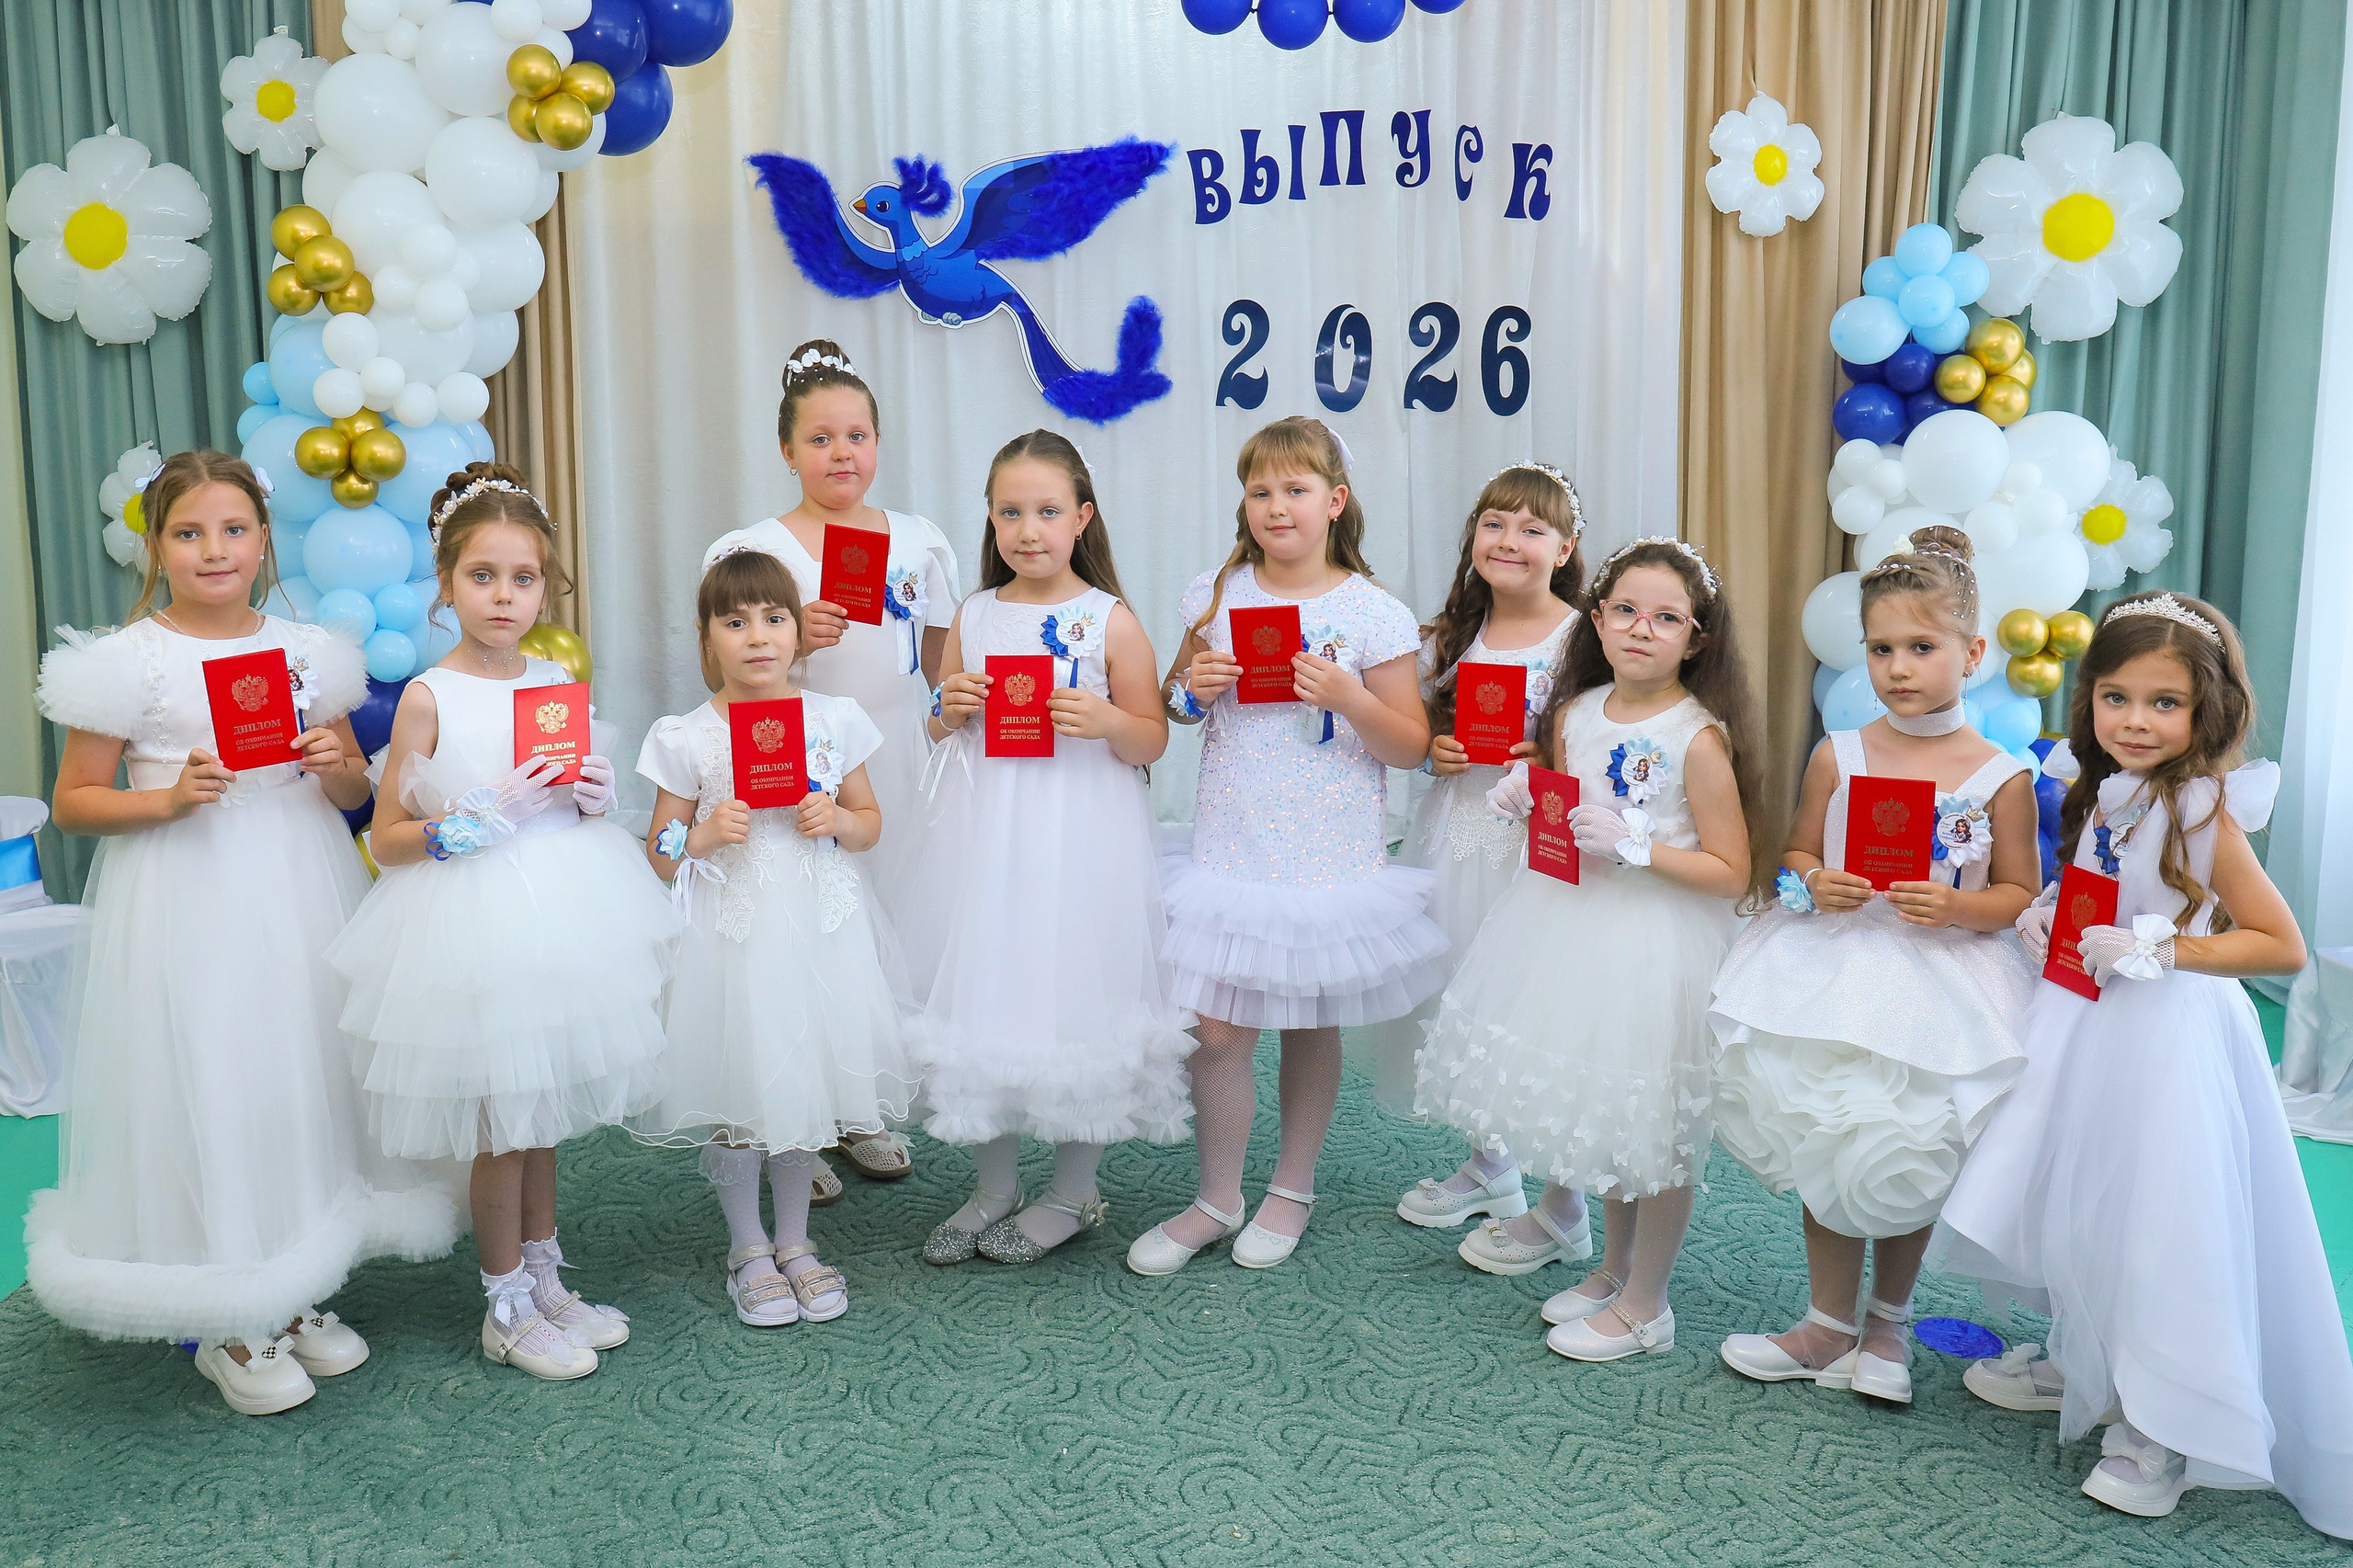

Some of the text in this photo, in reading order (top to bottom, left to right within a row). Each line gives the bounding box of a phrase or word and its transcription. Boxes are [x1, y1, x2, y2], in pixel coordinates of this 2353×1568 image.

[1187, 109, 1553, 224] ВЫПУСК
[1215, 299, 1532, 417] 2026
[834, 581, 872, 594] ДИПЛОМ
[1250, 665, 1291, 674] ДИПЛОМ
[233, 719, 281, 735] ДИПЛОМ
[1469, 723, 1510, 734] ДИПЛОМ
[530, 741, 576, 754] ДИПЛОМ
[750, 762, 793, 775] ДИПЛОМ
[1538, 831, 1567, 848] ДИПЛОМ
[1863, 845, 1914, 857] ДИПЛОМ
